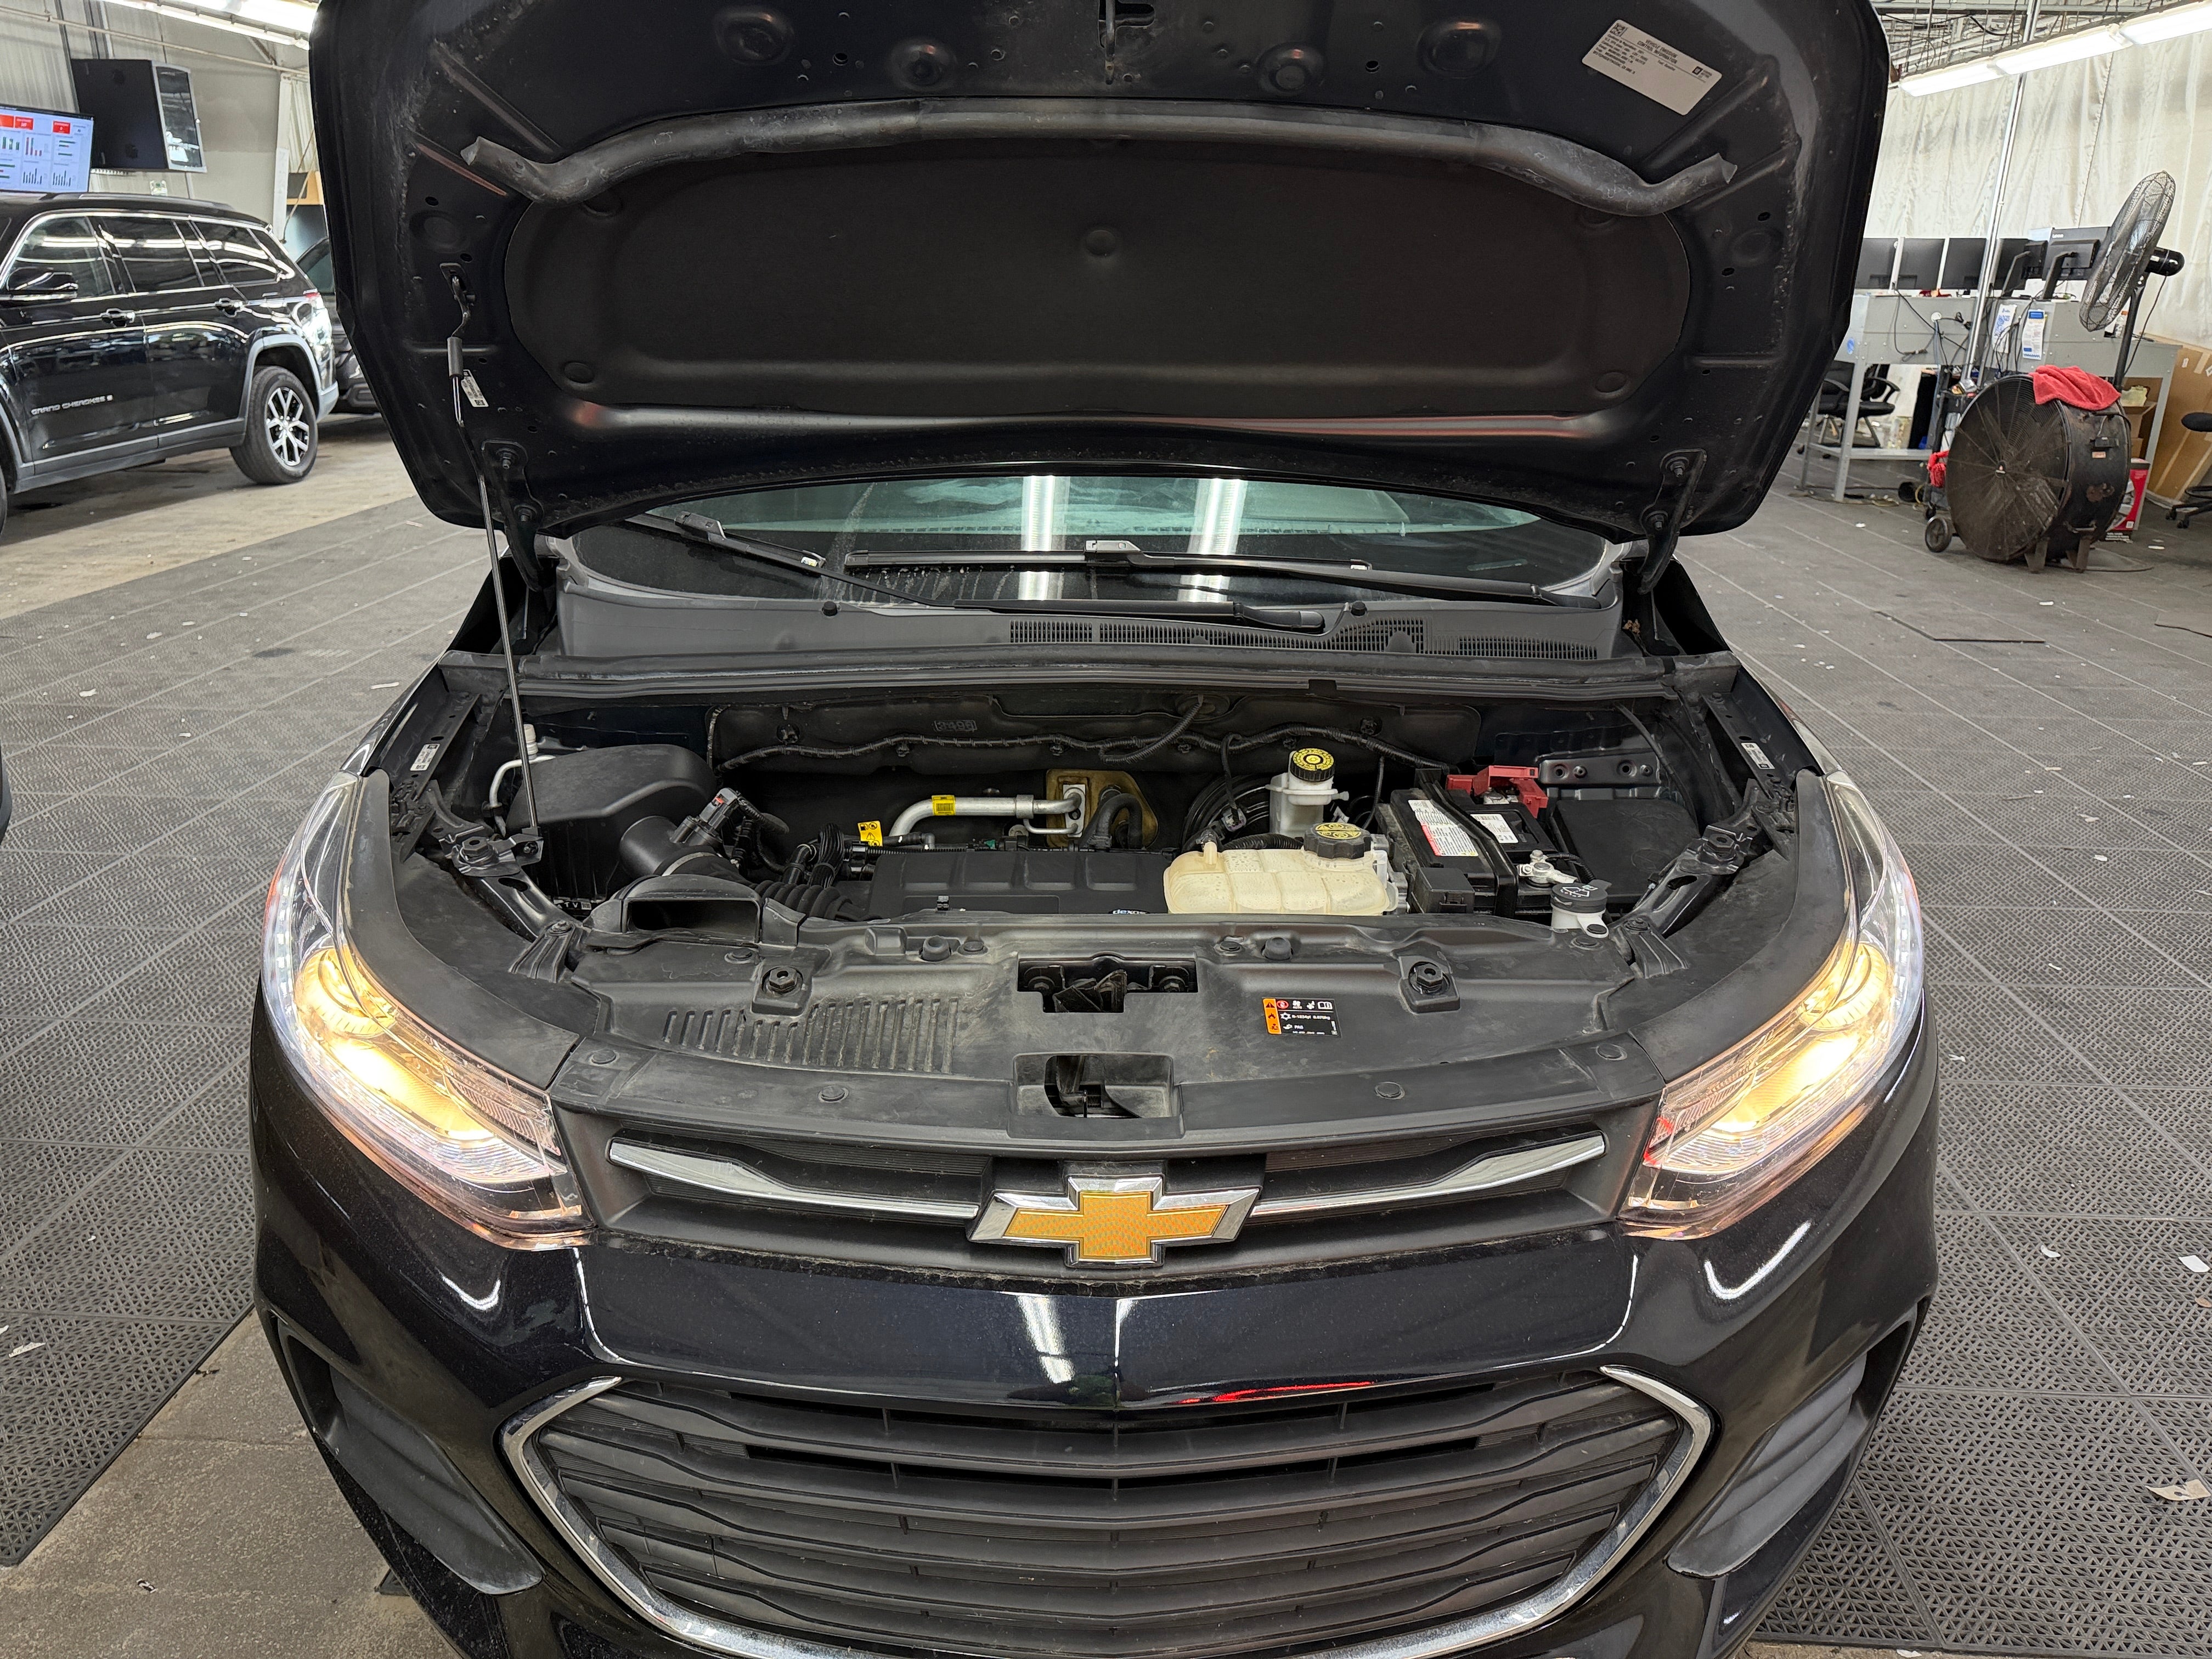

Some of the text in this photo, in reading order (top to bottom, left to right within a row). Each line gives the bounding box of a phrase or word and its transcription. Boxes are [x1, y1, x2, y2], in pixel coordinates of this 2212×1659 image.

[1637, 41, 1654, 52] CONTROL
[1654, 49, 1678, 64] INFORMATION
[31, 404, 60, 415] GRAND
[61, 396, 106, 409] CHEROKEE
